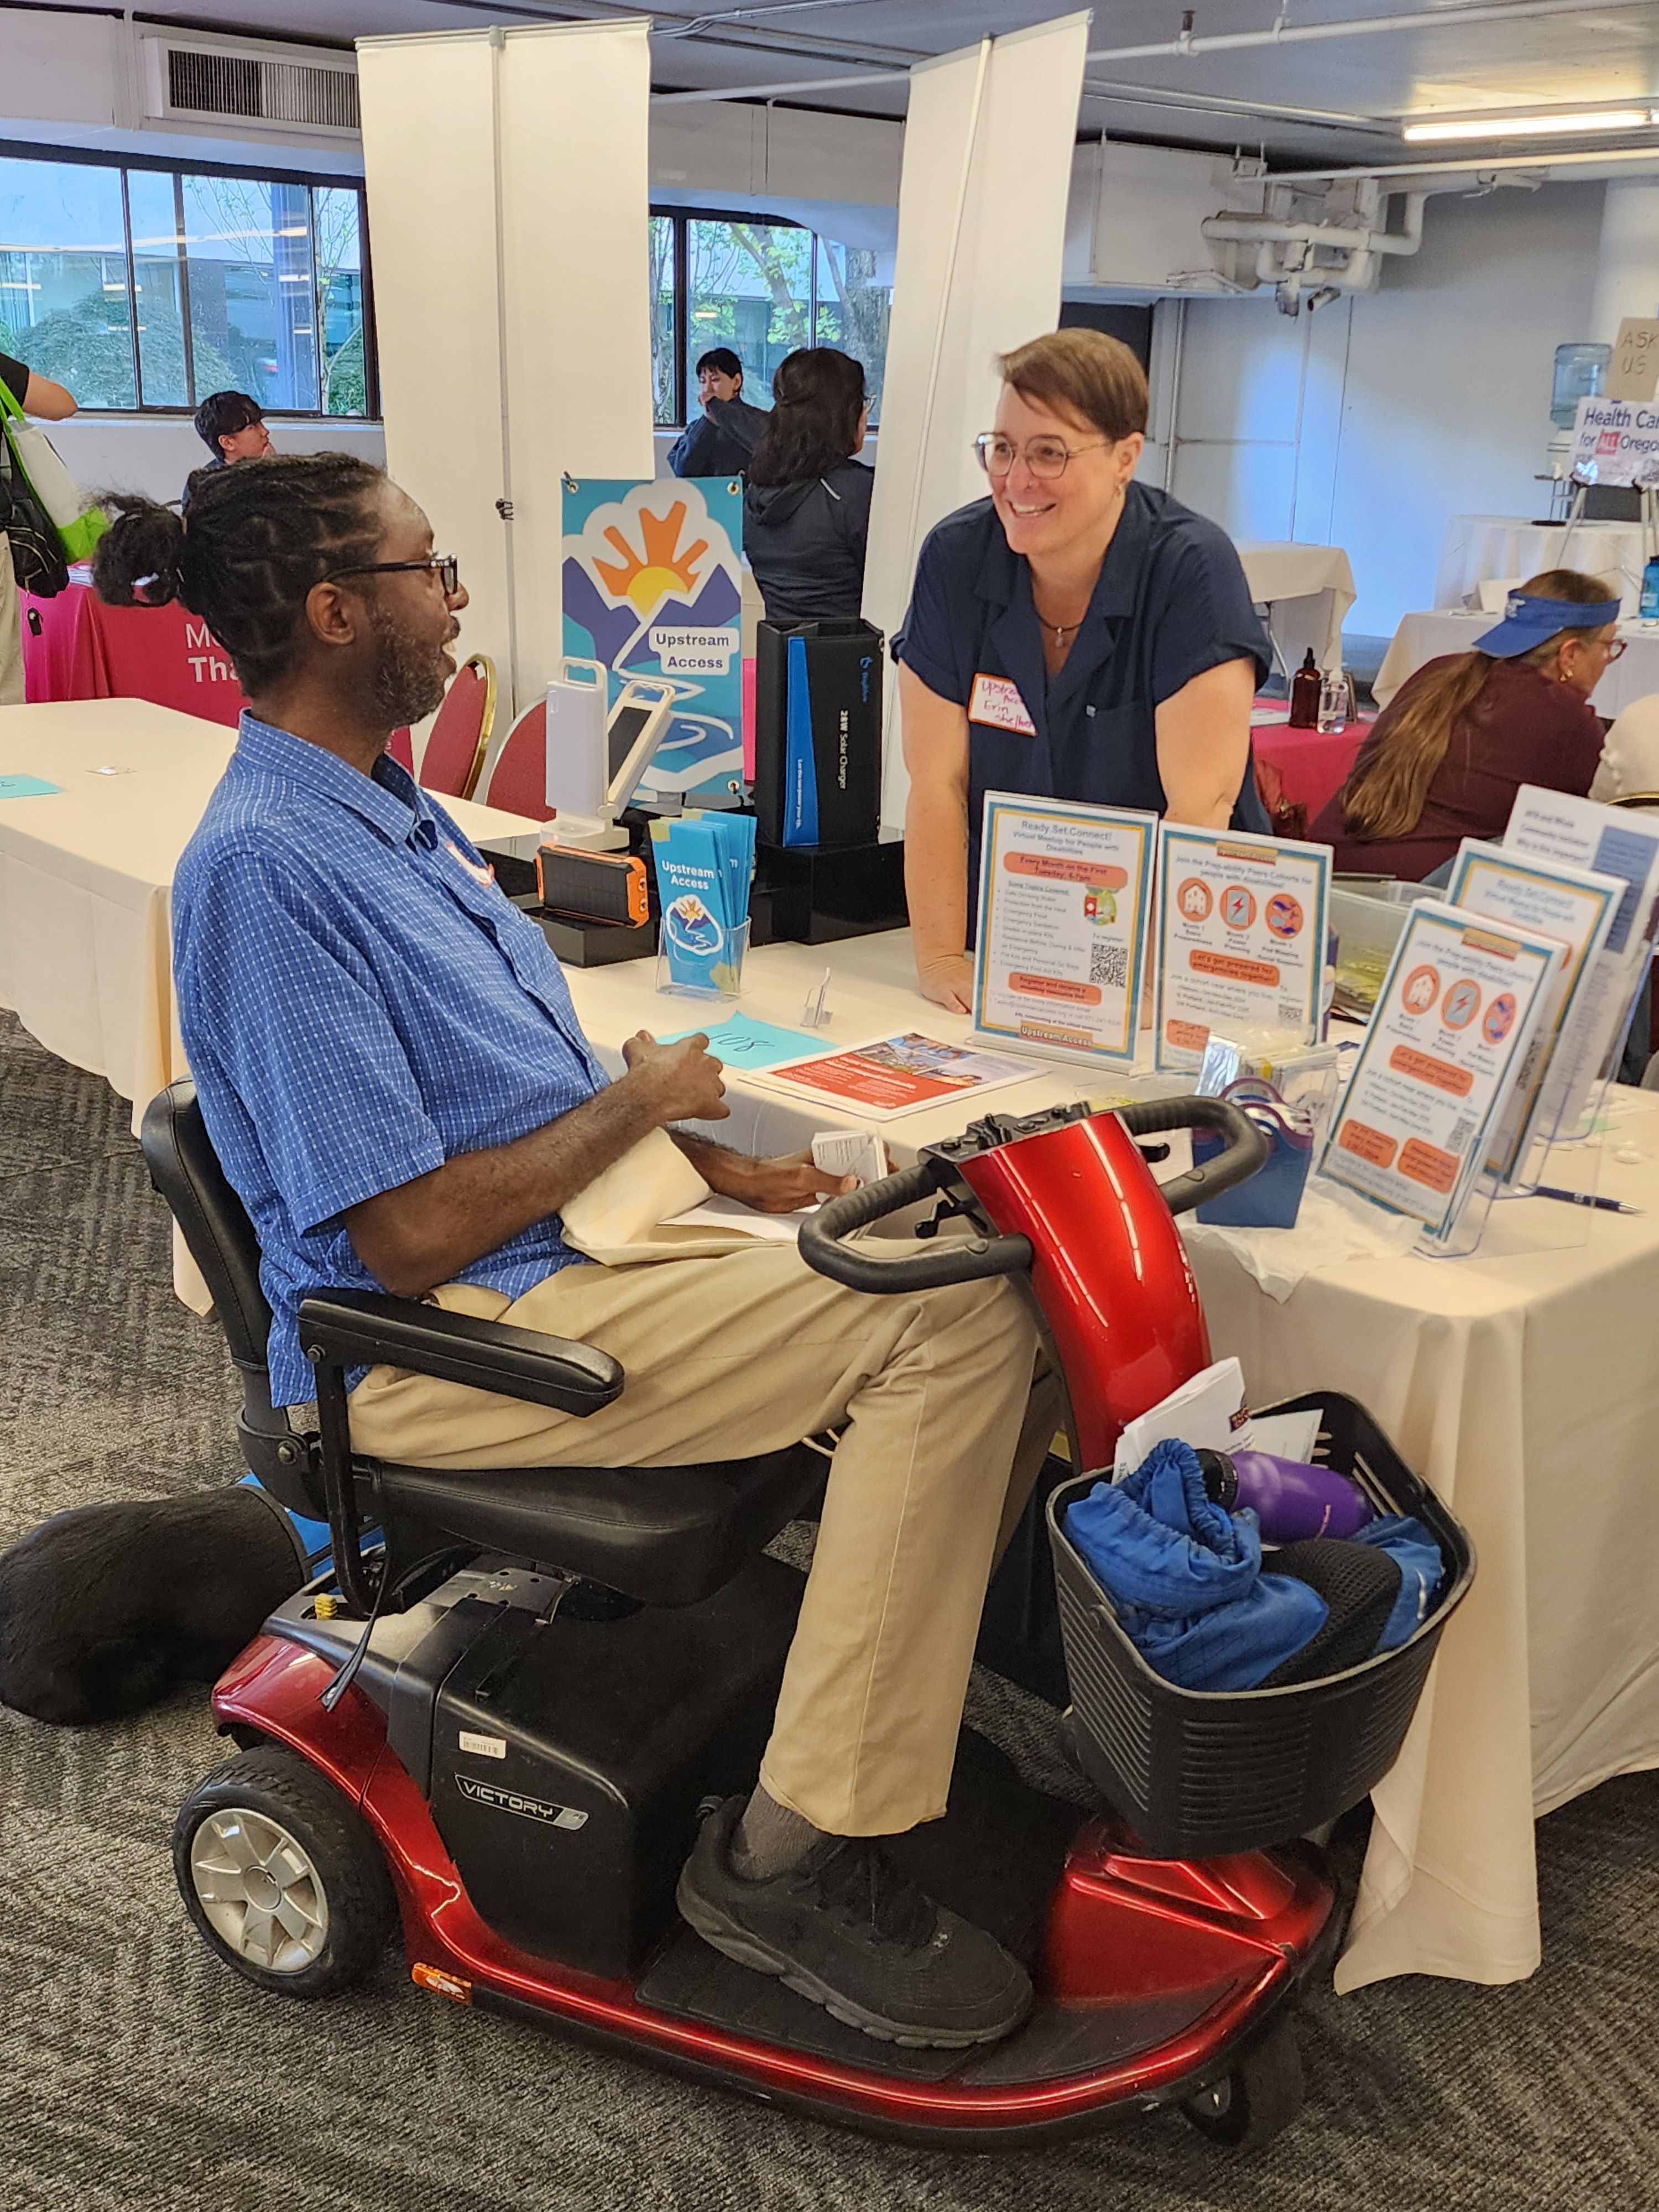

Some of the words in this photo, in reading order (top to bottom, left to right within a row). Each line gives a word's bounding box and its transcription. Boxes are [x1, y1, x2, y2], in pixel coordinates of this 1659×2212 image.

[1621, 332, 1659, 349] ASK
[1623, 355, 1646, 374] US
[1584, 407, 1631, 427] Health
[1580, 431, 1597, 447] for
[186, 623, 221, 648] M
[656, 633, 729, 648] Upstream
[667, 656, 723, 668] Access
[984, 700, 1009, 714] Erin
[839, 733, 848, 754] Solar
[838, 755, 848, 790] Charger
[1013, 832, 1035, 841] Virtual
[1022, 821, 1049, 834] Ready
[661, 860, 715, 879] Upstream
[670, 875, 709, 891] Access
[1022, 1026, 1061, 1042] Upstream
[1062, 1032, 1092, 1047] Access
[463, 1780, 554, 1818] VICTORY
